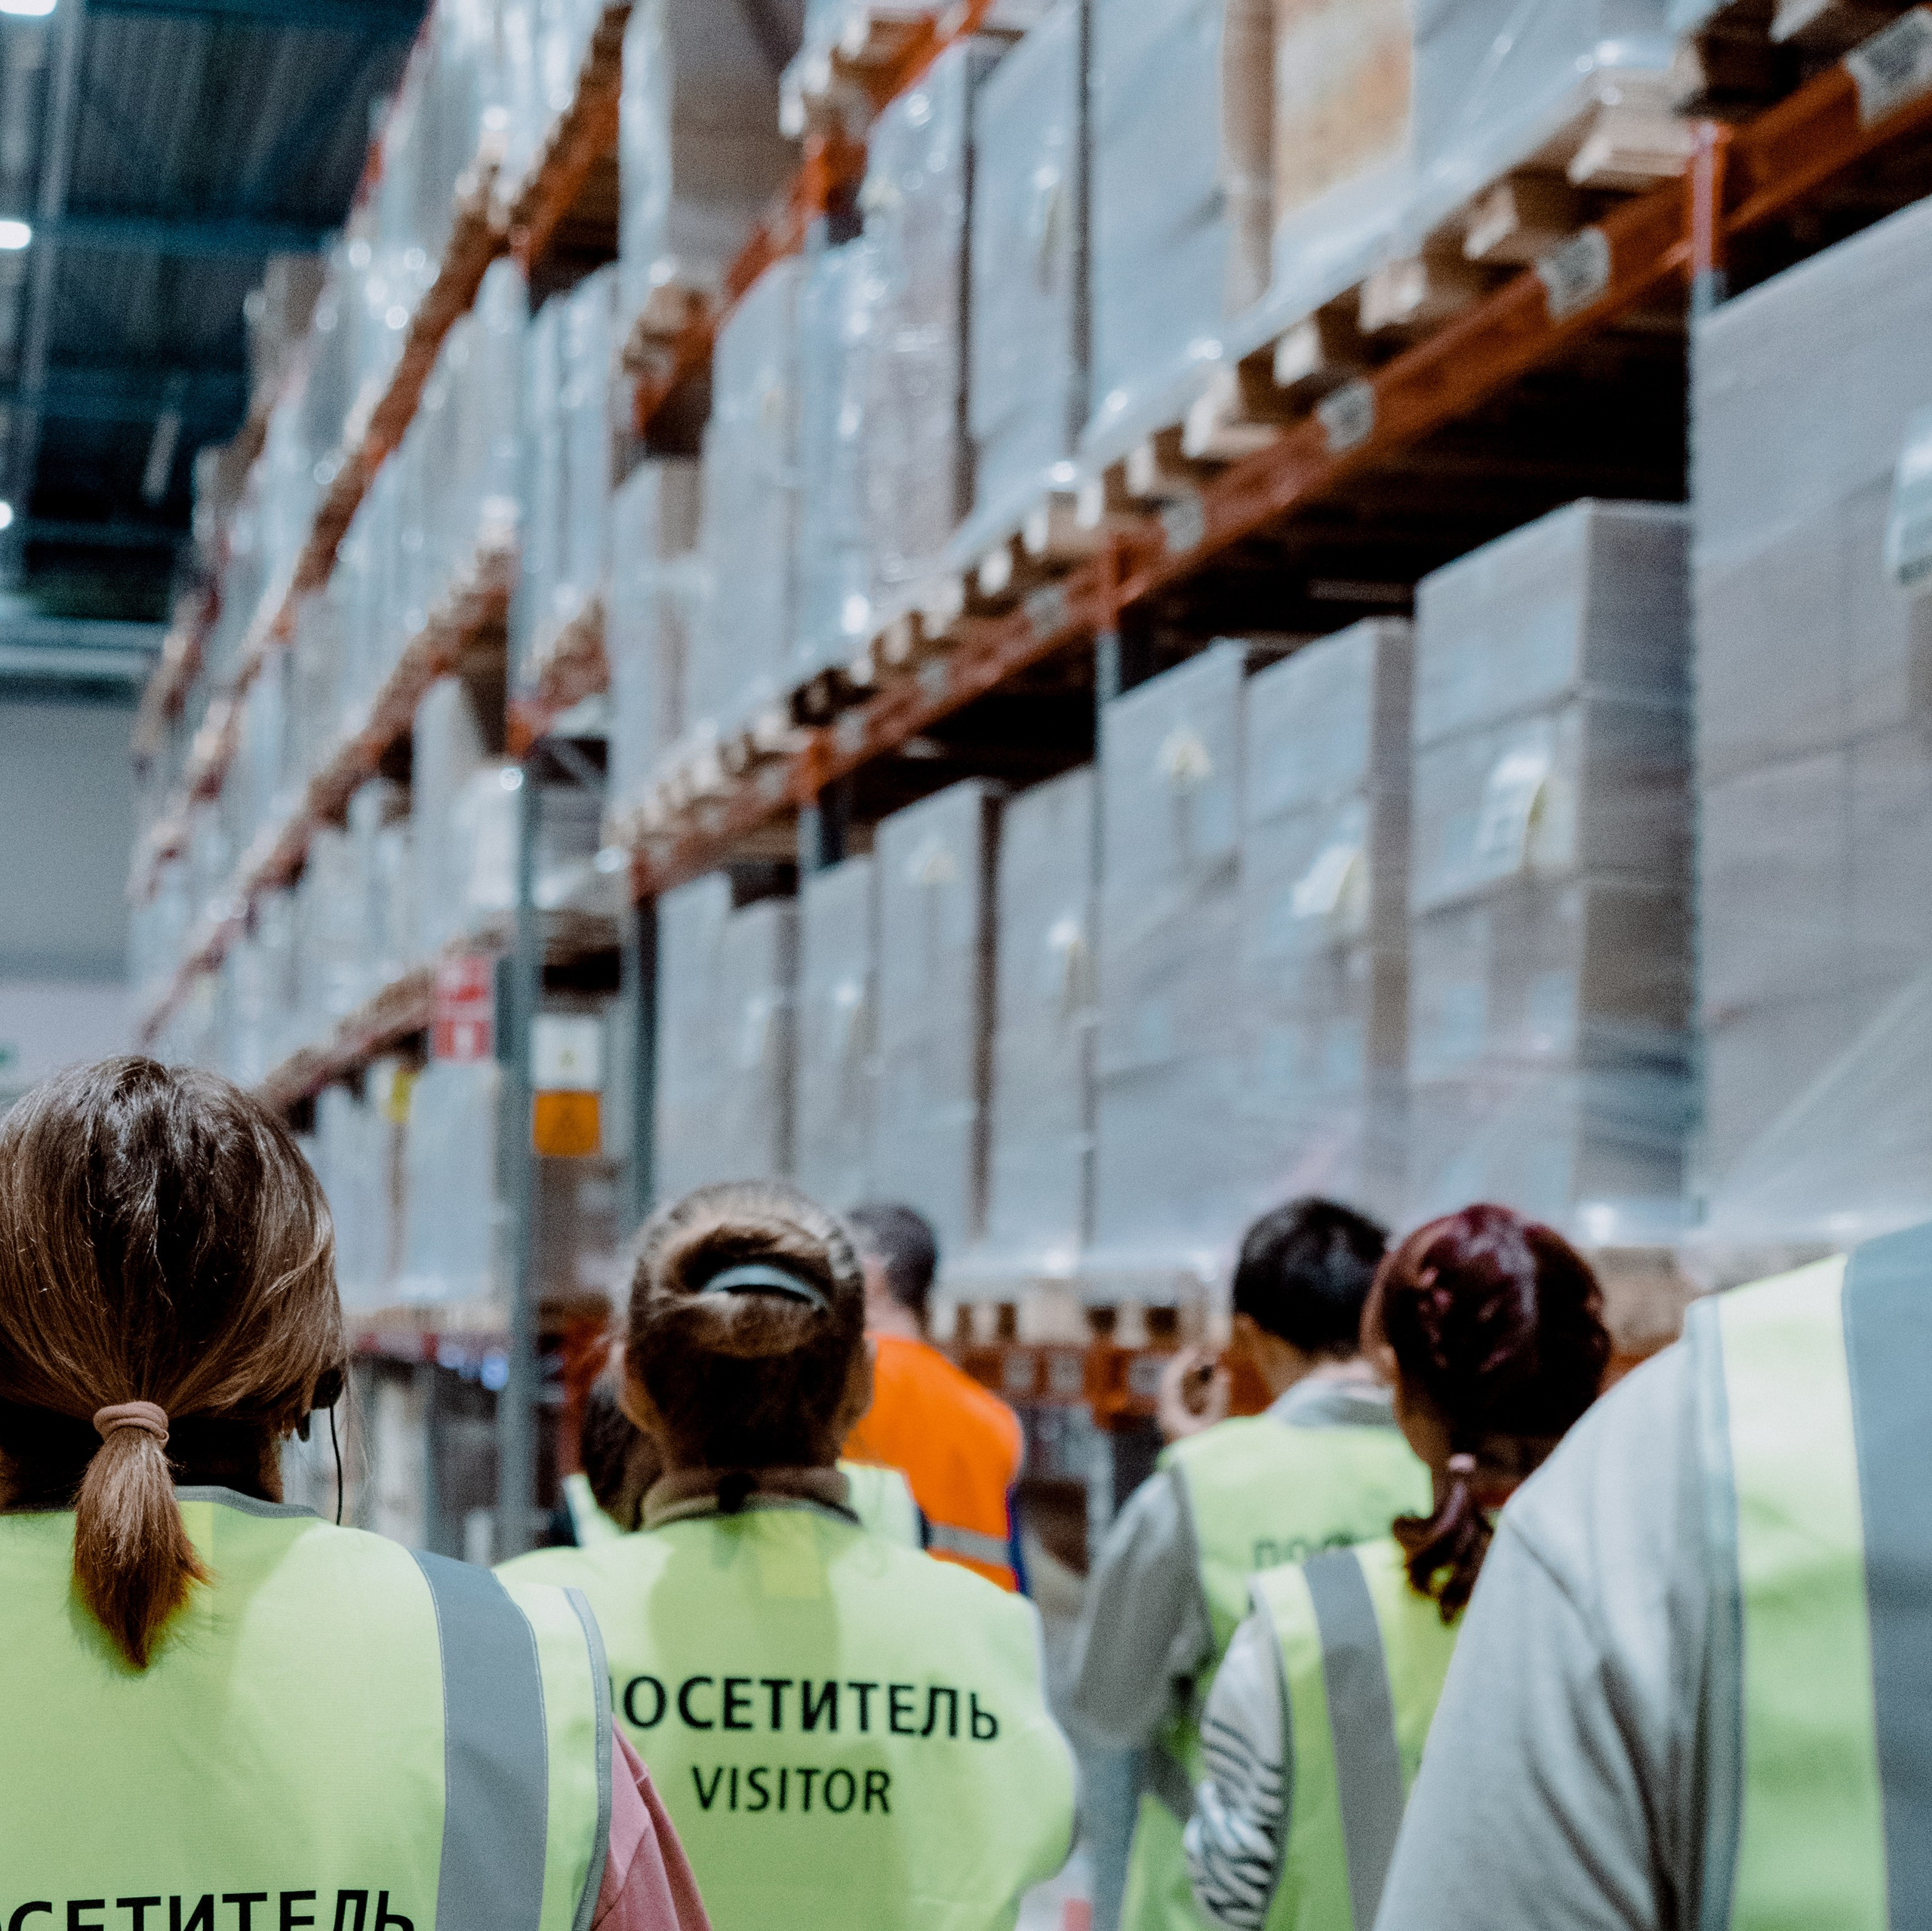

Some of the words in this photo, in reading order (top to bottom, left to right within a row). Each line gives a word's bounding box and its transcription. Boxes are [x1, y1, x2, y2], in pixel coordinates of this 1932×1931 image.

[608, 1675, 998, 1740] ОСЕТИТЕЛЬ
[691, 1766, 891, 1814] VISITOR
[0, 1889, 414, 1931] СЕТИТЕЛЬ
